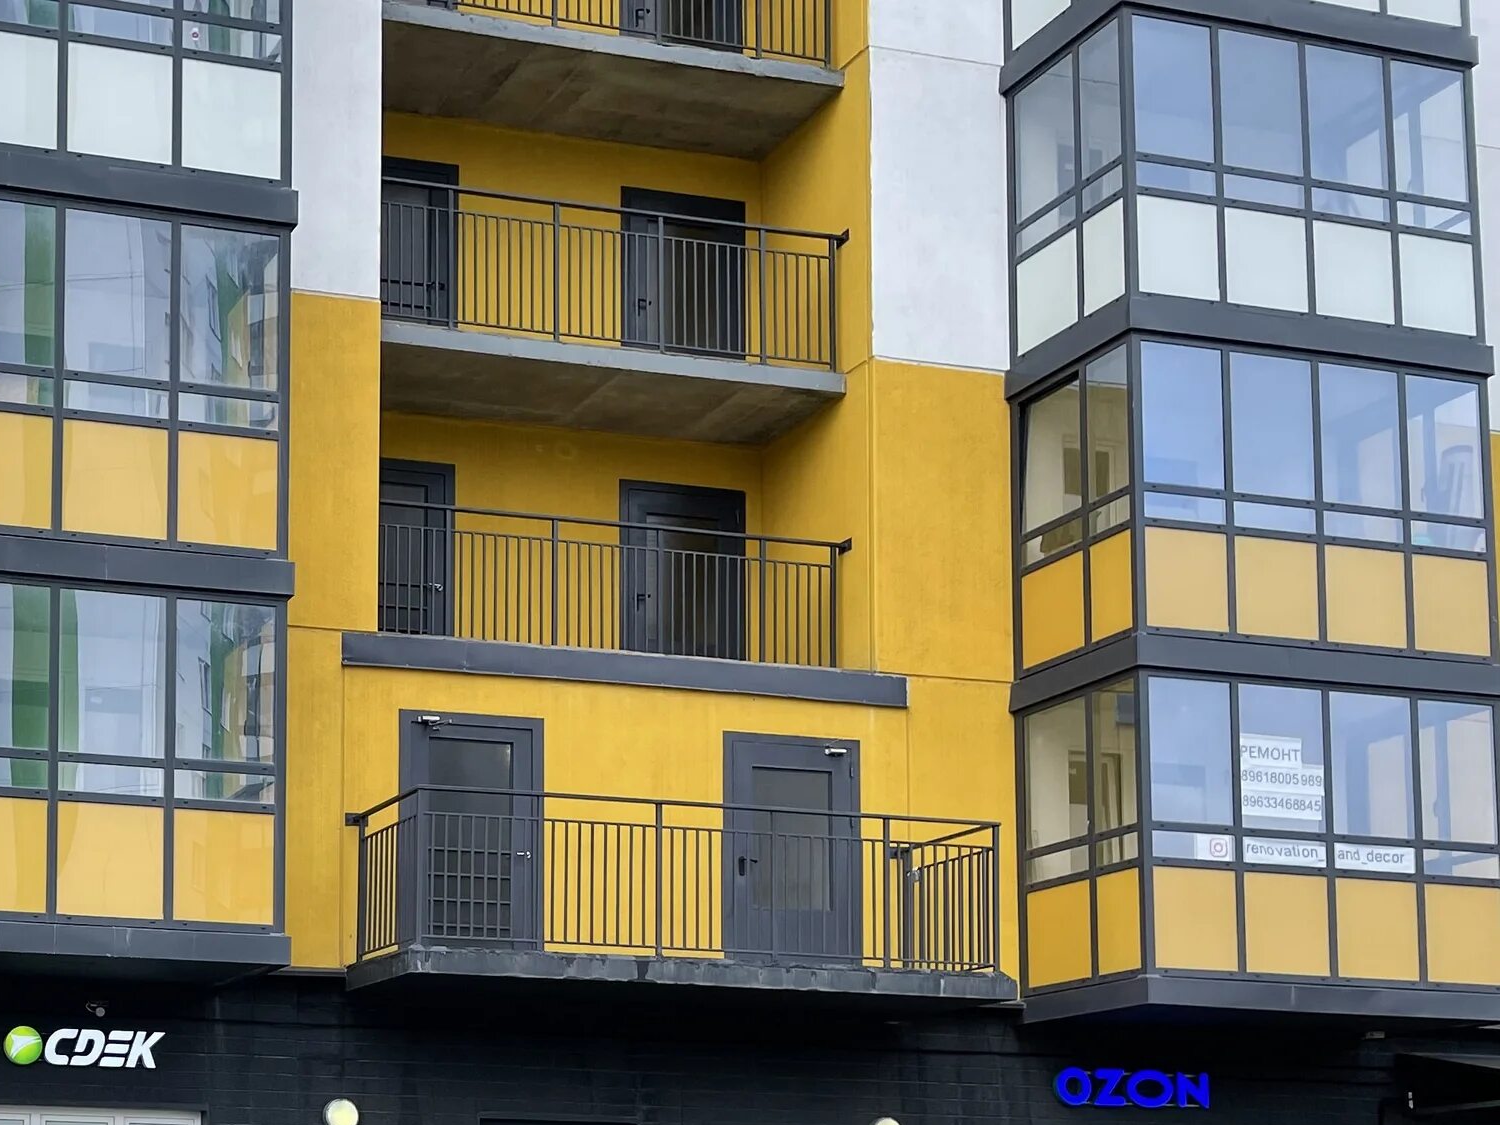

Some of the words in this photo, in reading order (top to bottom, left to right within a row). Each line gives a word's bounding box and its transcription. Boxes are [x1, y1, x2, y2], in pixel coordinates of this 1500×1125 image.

[1240, 744, 1301, 762] РЕМОНТ
[44, 1028, 166, 1069] CDEK
[1056, 1066, 1210, 1109] OZON
